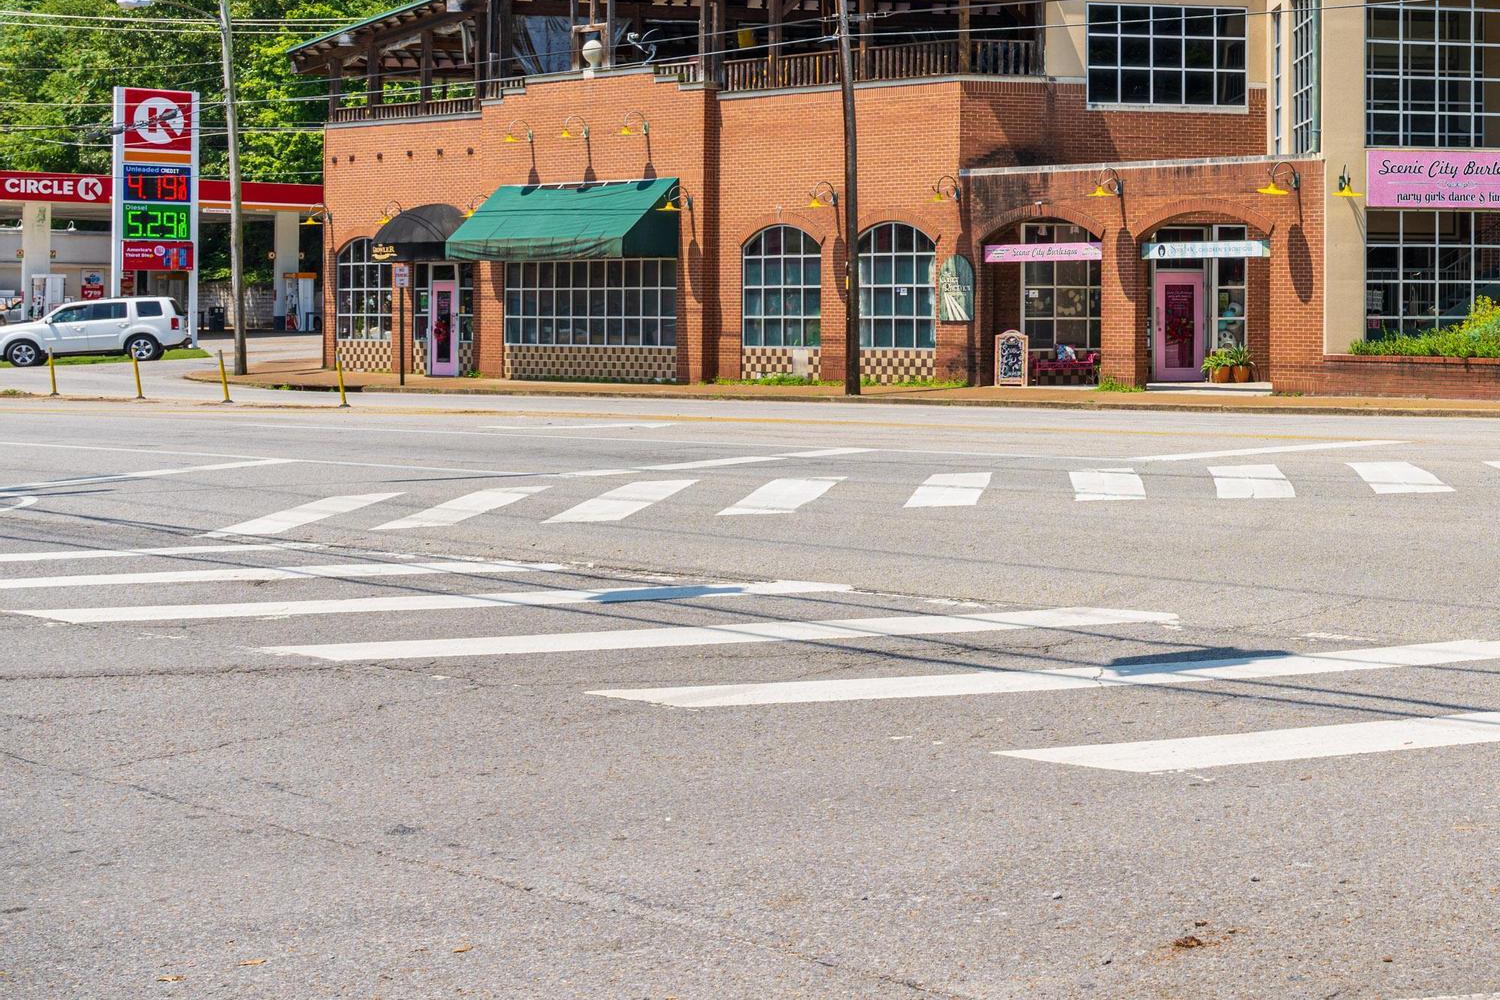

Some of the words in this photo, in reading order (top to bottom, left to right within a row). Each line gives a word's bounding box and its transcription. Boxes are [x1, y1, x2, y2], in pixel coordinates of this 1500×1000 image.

[146, 105, 181, 141] K
[1378, 159, 1424, 175] Scenic
[1428, 160, 1459, 178] City
[5, 177, 74, 195] CIRCLE
[83, 180, 101, 199] K
[1396, 192, 1422, 203] party
[1425, 191, 1446, 203] girls
[1448, 191, 1476, 202] dance
